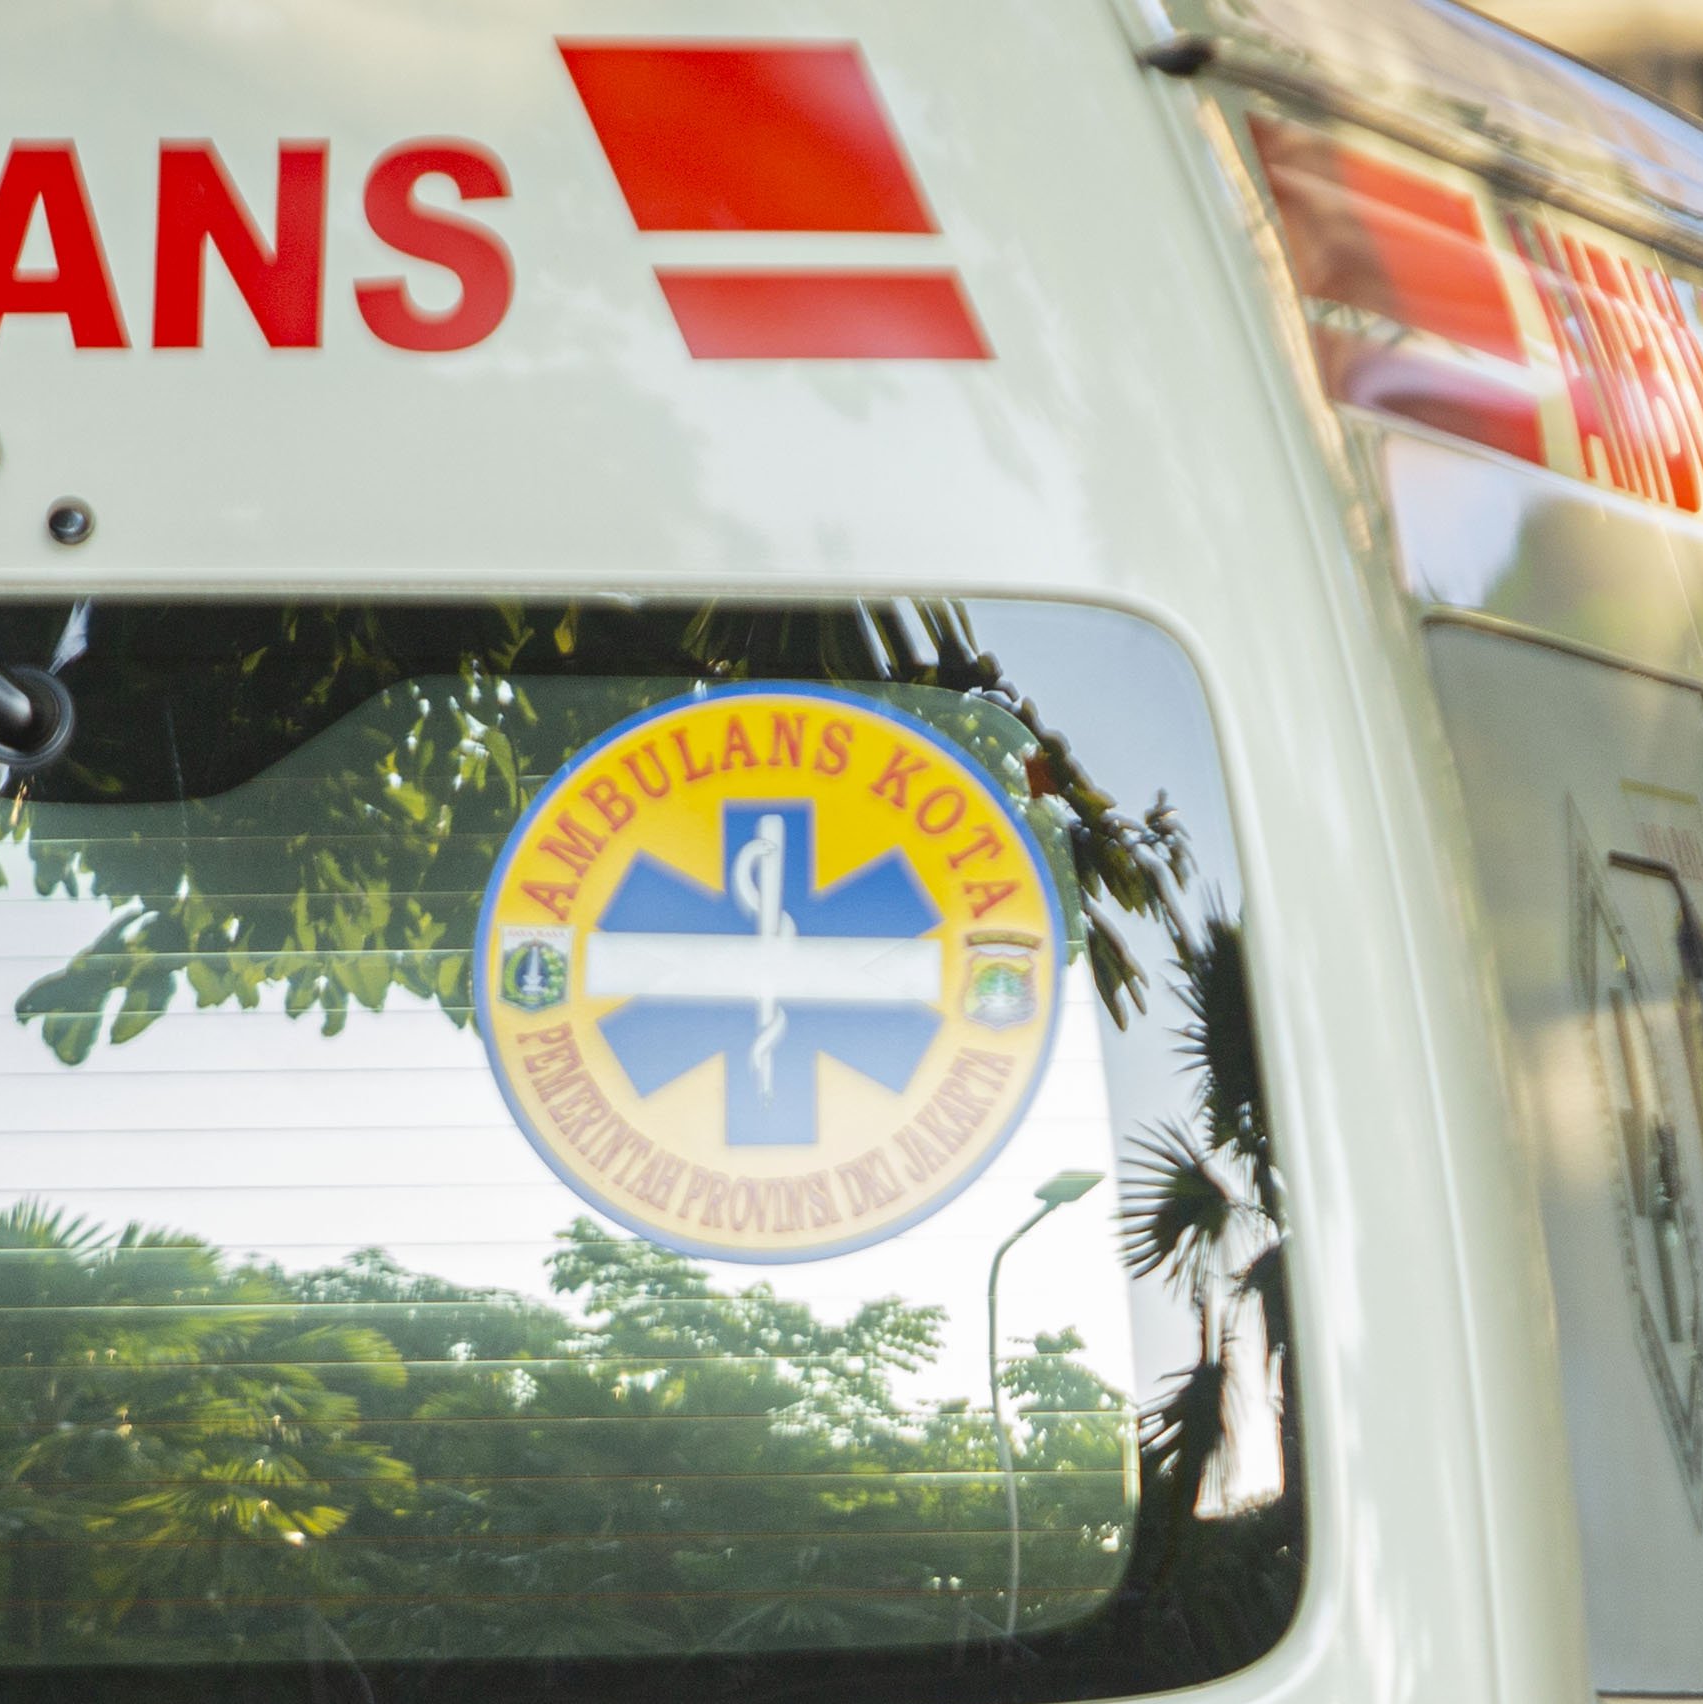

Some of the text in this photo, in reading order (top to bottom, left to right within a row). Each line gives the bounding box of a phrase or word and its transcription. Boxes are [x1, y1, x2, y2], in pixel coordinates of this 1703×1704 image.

[519, 709, 1024, 922] AMBULANS KOTA
[516, 1020, 1016, 1234] PEMERINTAH PROVINSI DKI JAKARTA
